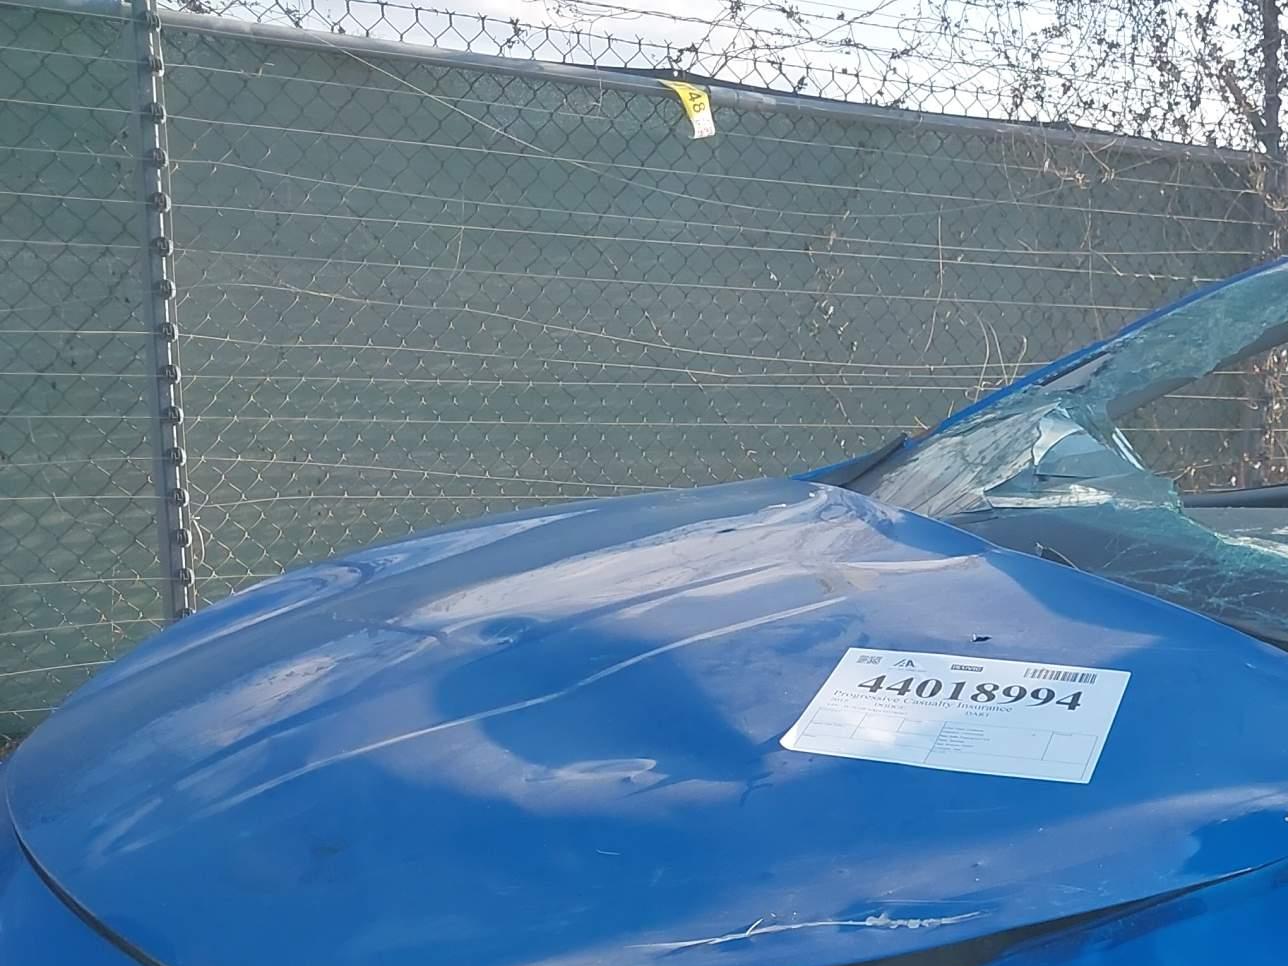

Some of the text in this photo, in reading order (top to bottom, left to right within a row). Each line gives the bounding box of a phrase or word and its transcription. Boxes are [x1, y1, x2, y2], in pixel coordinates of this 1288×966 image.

[832, 689, 901, 705] Progressive
[903, 696, 954, 710] Casualty
[957, 701, 1014, 713] Insurance
[858, 674, 1084, 711] 44018994
